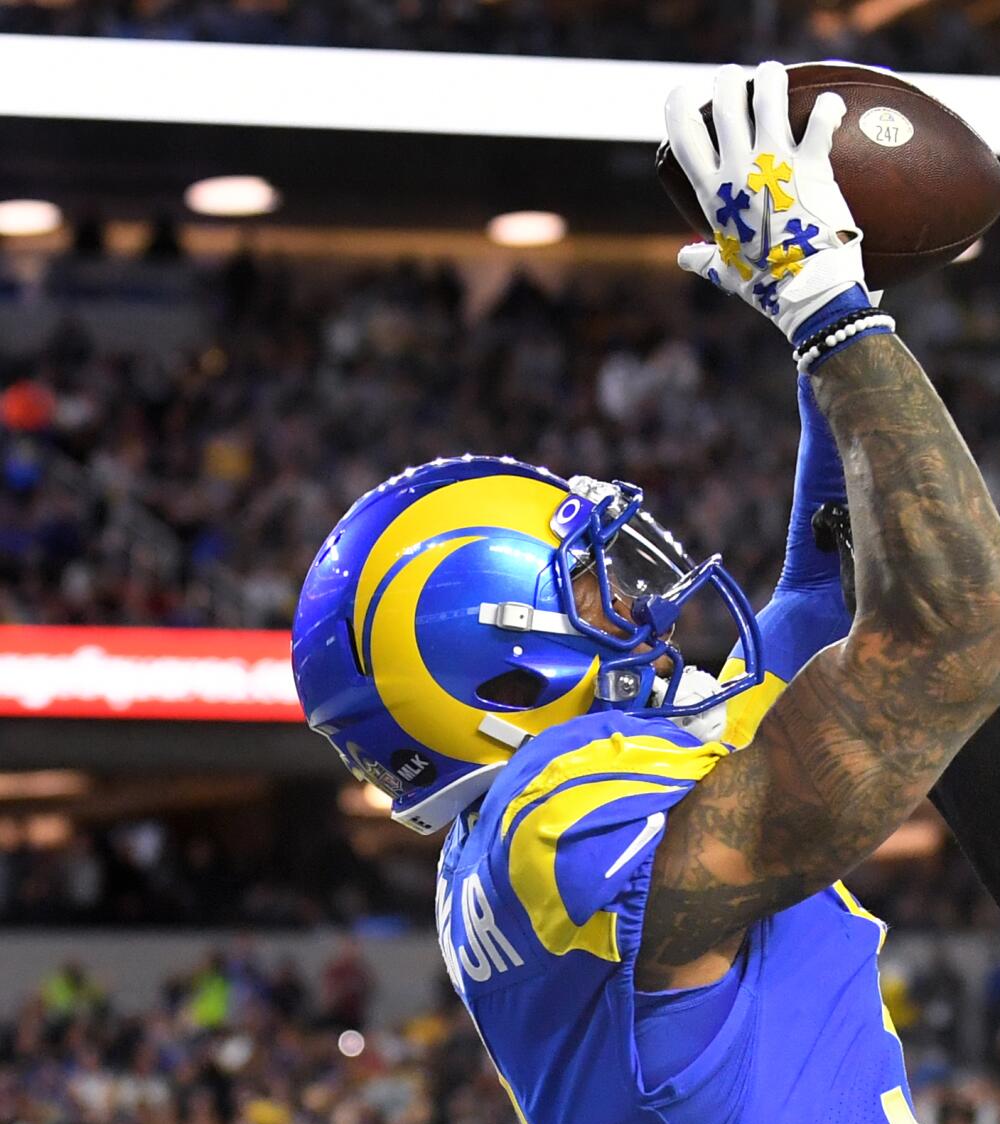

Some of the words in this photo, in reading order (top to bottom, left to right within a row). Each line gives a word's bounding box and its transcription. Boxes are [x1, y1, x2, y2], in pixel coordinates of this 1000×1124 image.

[875, 125, 899, 143] 247
[397, 753, 429, 781] MLK
[458, 872, 525, 983] JR
